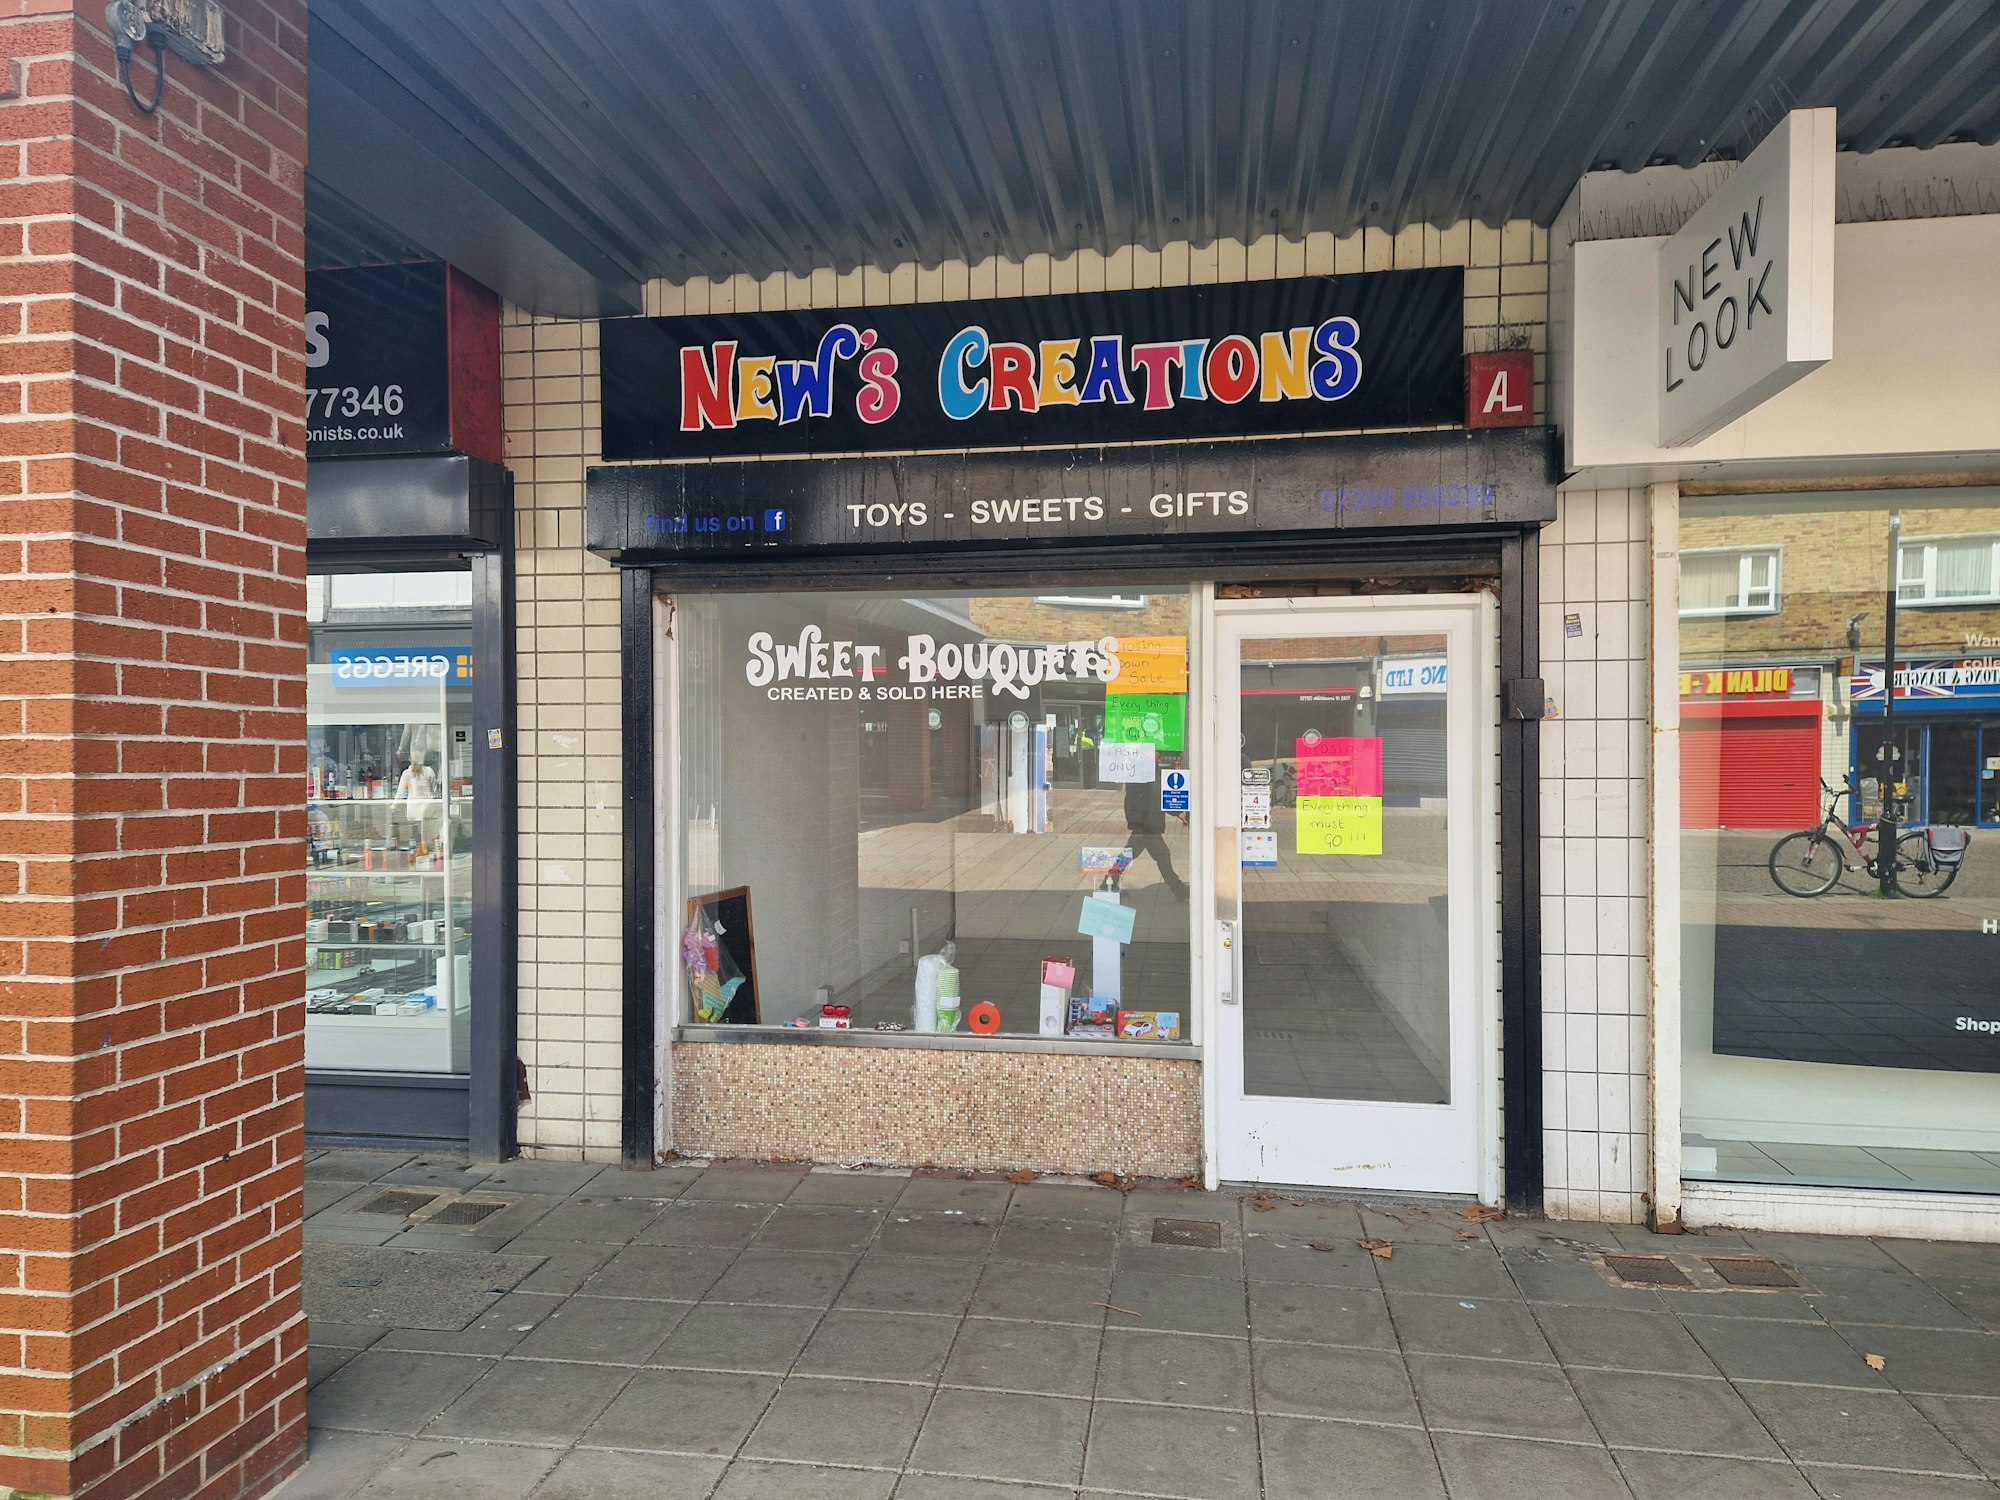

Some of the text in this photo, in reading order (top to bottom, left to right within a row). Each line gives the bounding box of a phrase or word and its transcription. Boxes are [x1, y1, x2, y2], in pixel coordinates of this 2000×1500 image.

[1673, 195, 1764, 325] NEW
[1666, 260, 1773, 393] LOOK
[680, 316, 1362, 431] NEW'S CREATIONS
[306, 384, 404, 418] 77346
[646, 512, 688, 535] find
[694, 515, 720, 533] us
[727, 513, 755, 532] on
[847, 502, 927, 527] TOYS
[970, 496, 1104, 524] SWEETS
[1150, 491, 1249, 517] GIFTS
[745, 624, 1120, 700] SWEET BOUQUETS
[1115, 640, 1161, 660] losing
[767, 685, 983, 701] CREATED & SOLD HERE
[1311, 821, 1345, 830] must
